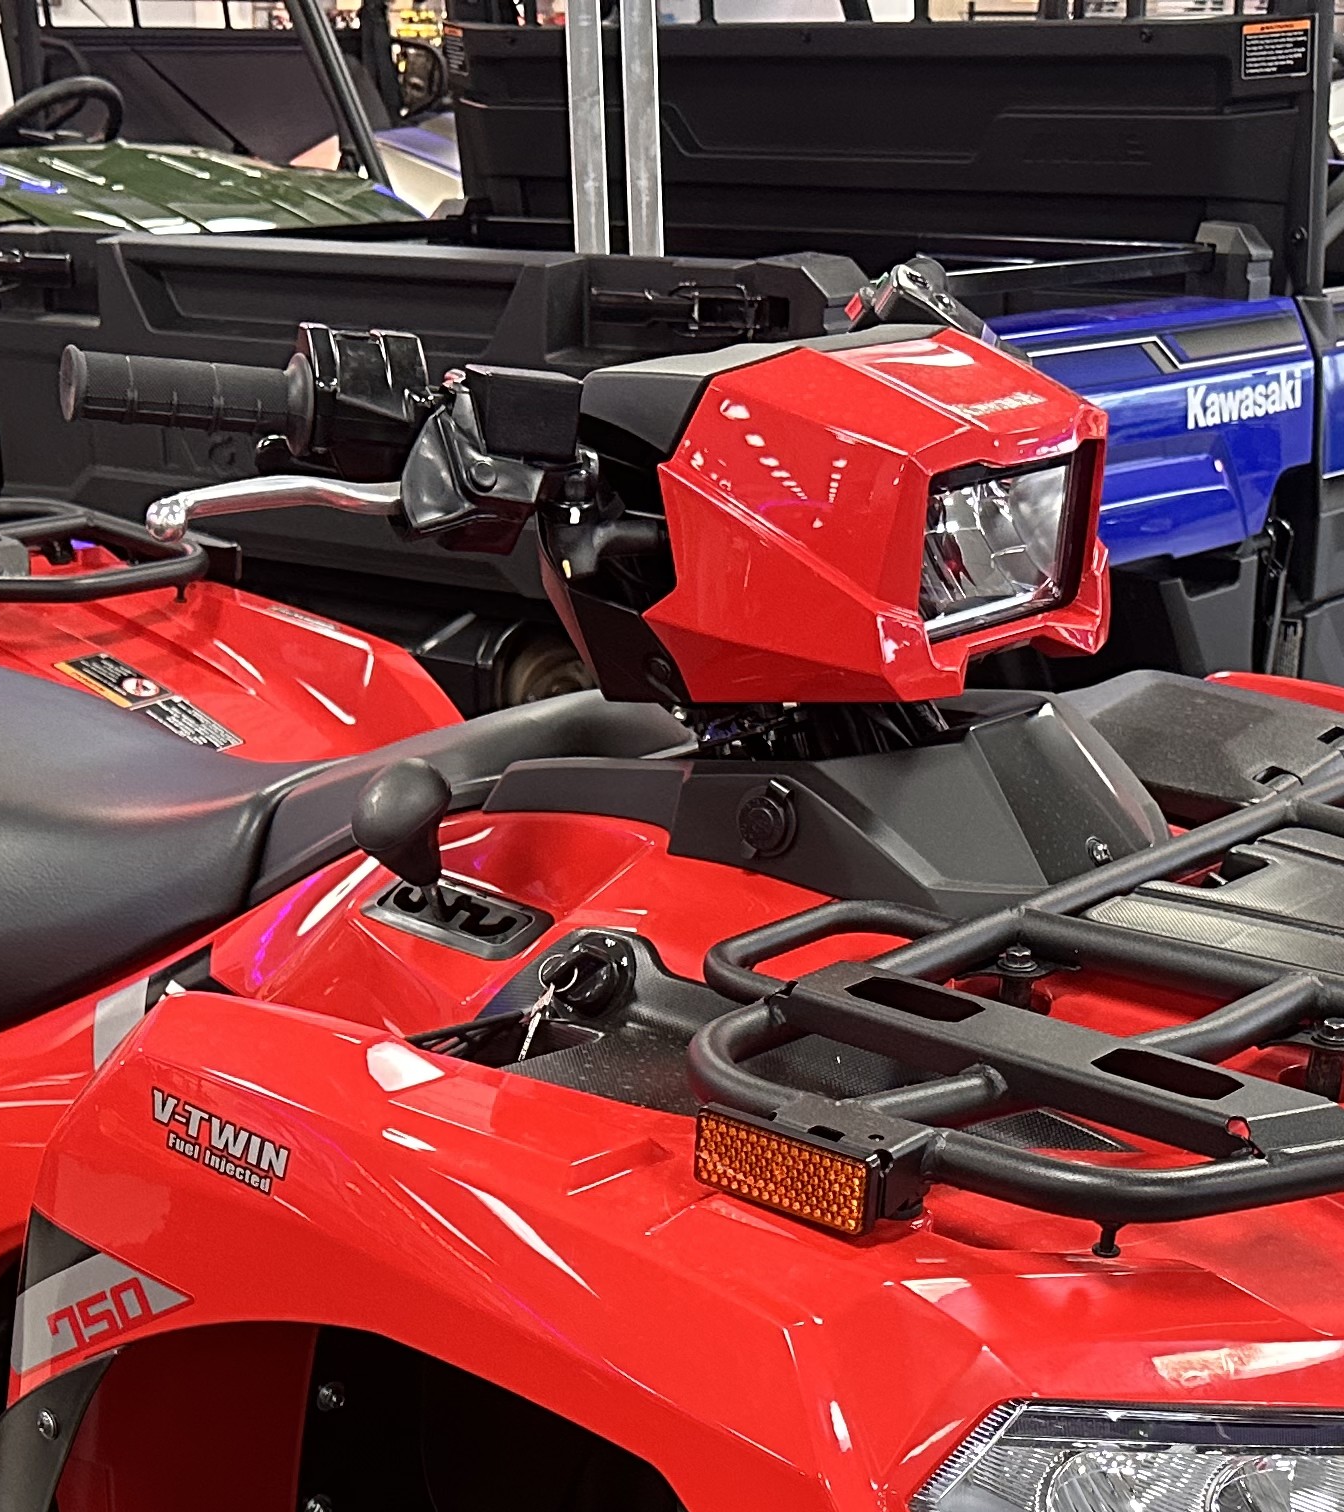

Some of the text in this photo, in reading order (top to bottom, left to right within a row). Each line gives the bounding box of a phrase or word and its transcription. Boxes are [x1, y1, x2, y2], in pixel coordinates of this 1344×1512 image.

[1187, 368, 1302, 430] Kawasaki
[153, 1088, 289, 1178] V-TWIN
[168, 1132, 271, 1193] Fuel Injected
[46, 1276, 154, 1350] 750
